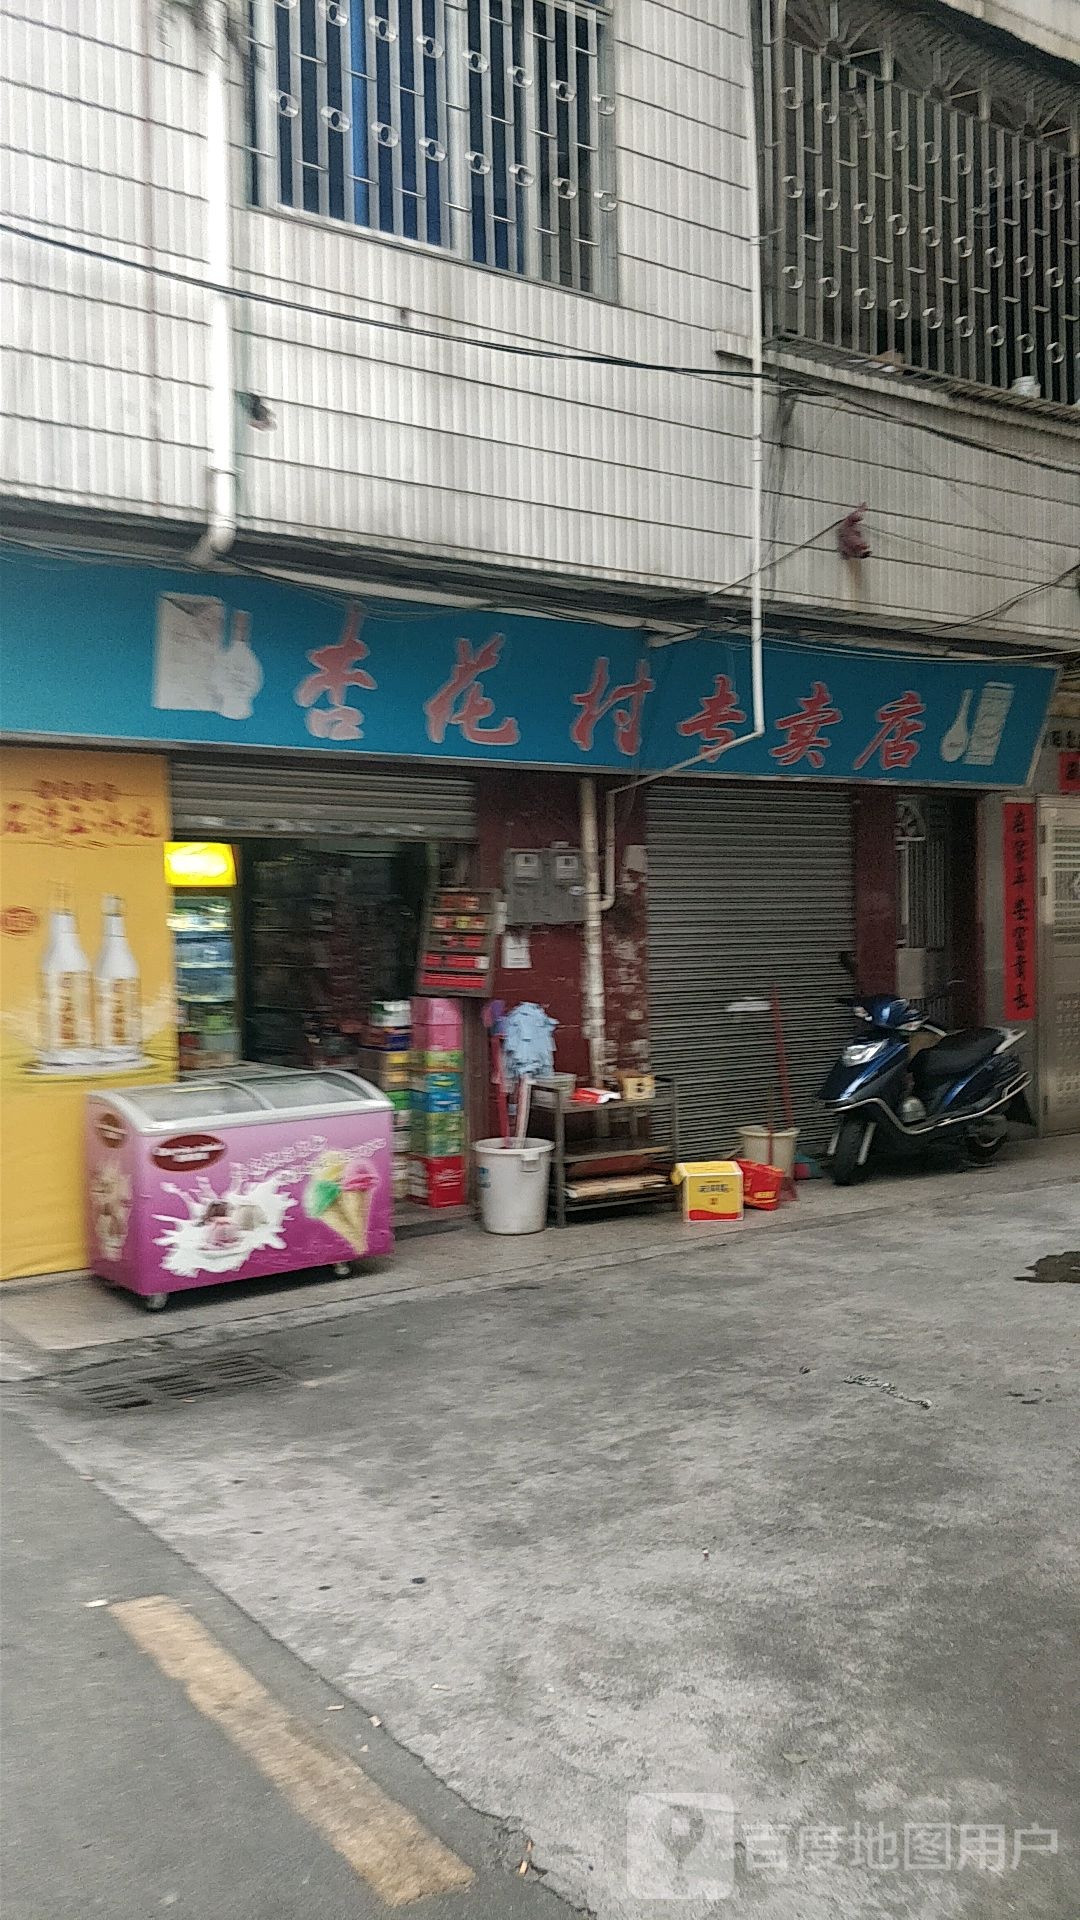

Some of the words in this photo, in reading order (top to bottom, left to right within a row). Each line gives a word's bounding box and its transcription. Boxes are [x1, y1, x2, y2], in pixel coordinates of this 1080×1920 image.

[294, 600, 927, 771] 杏花村专卖店
